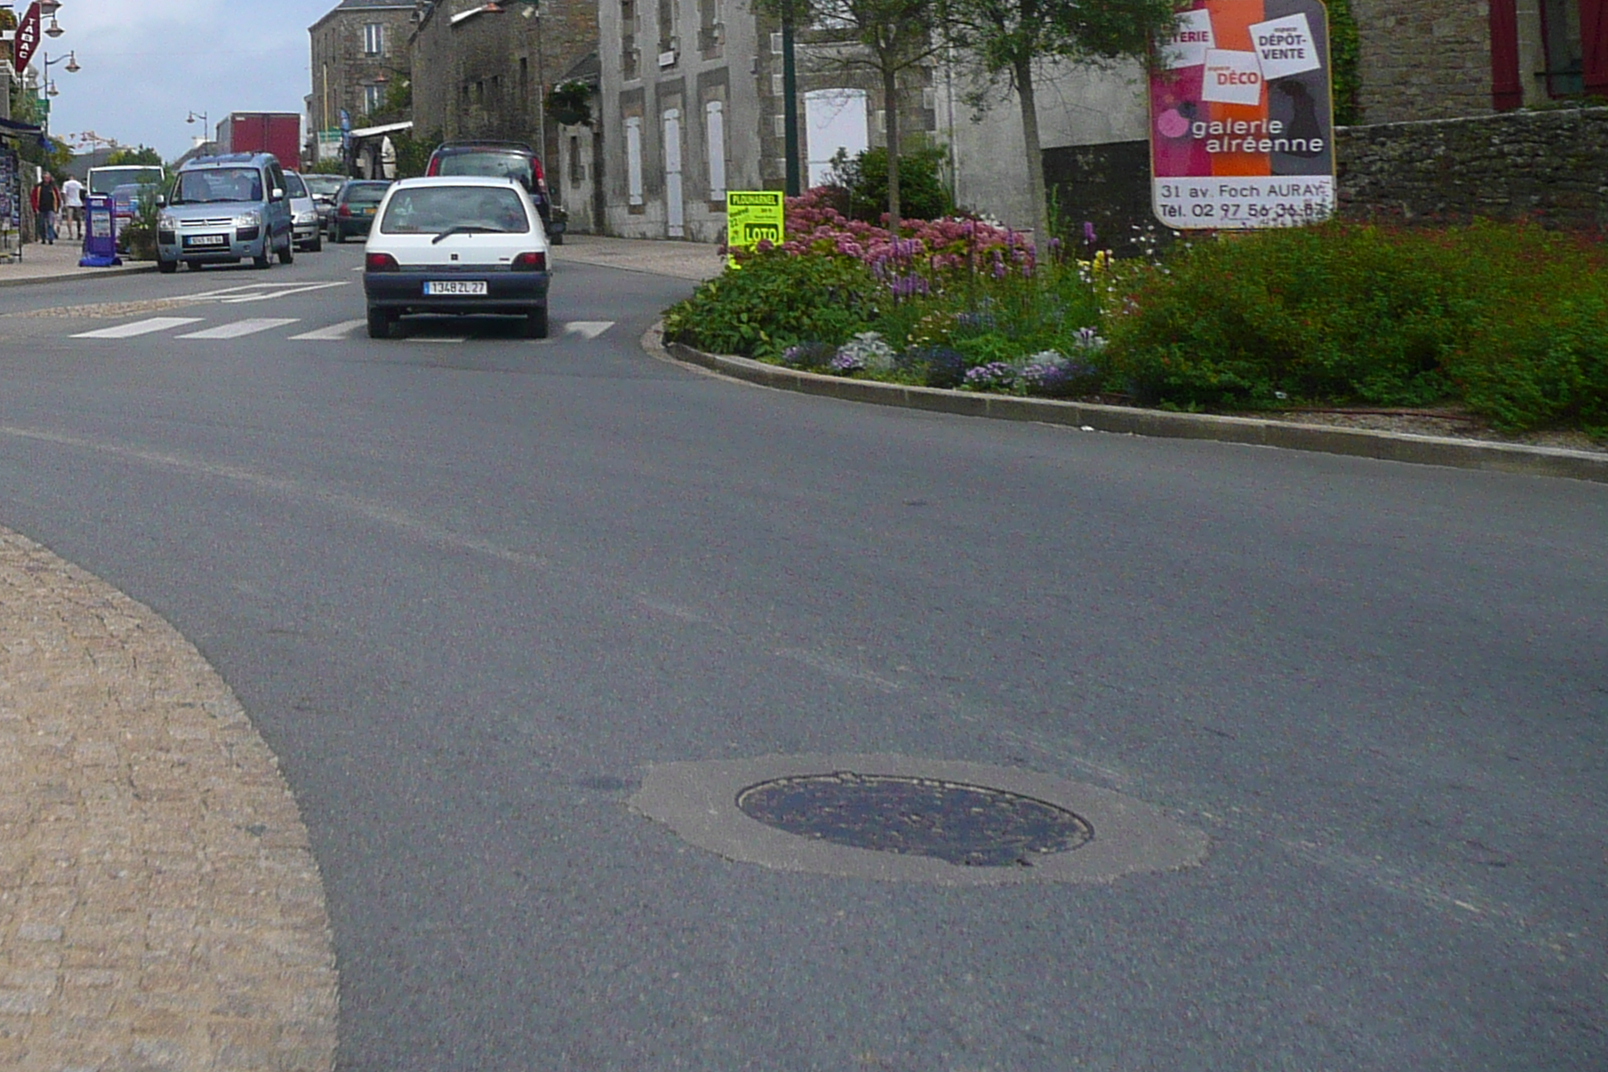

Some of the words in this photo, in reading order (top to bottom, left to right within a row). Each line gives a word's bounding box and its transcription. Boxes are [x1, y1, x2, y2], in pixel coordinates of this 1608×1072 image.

[19, 18, 37, 59] TABAC
[1172, 31, 1210, 44] TERIE
[1259, 33, 1307, 47] DÉPÔT-
[1261, 48, 1306, 60] VENTE
[1217, 69, 1259, 86] DÉCO
[1191, 118, 1284, 139] galerie
[1205, 135, 1325, 153] alréenne
[1161, 185, 1180, 199] 31
[1219, 185, 1260, 198] Foch
[1267, 184, 1321, 198] AURAY
[1160, 204, 1187, 218] Tél.
[1192, 204, 1214, 218] 02
[1220, 204, 1241, 218] 97
[1248, 204, 1270, 218] 56
[746, 227, 778, 242] LOTO
[432, 282, 457, 293] 1348
[458, 282, 471, 293] ZL
[472, 282, 485, 293] 27
